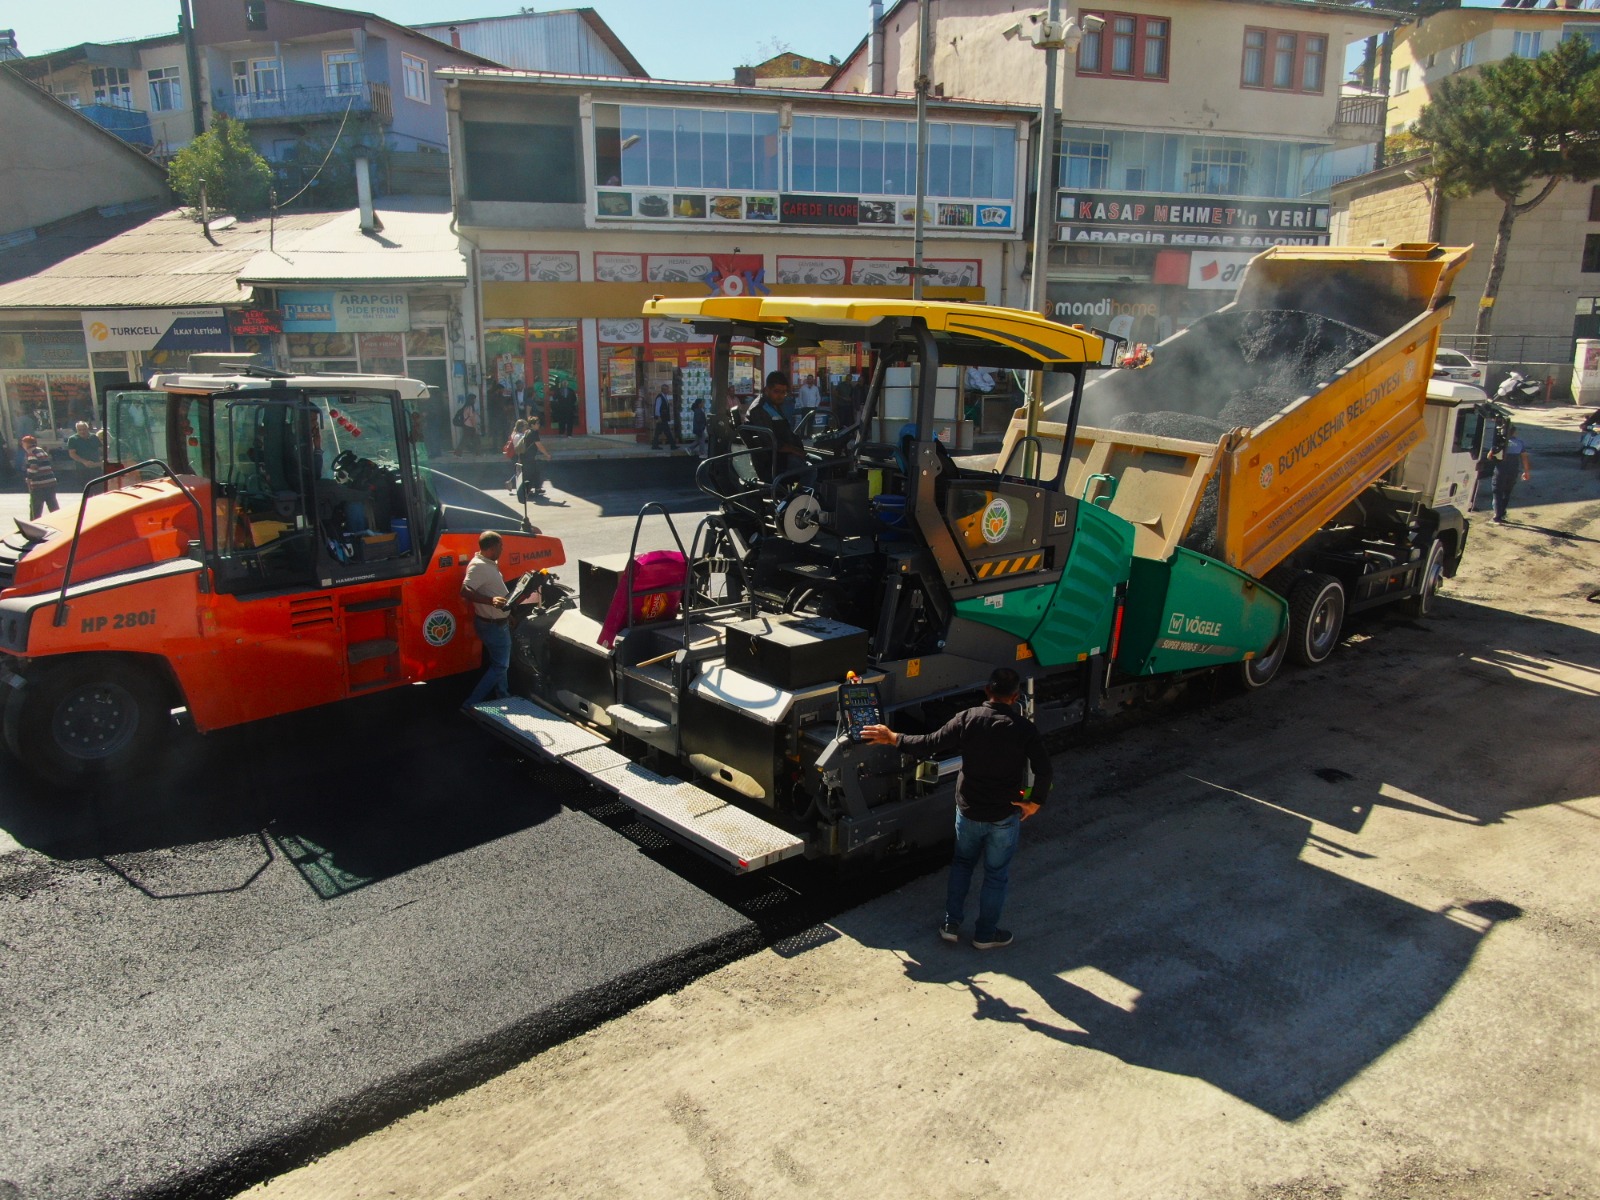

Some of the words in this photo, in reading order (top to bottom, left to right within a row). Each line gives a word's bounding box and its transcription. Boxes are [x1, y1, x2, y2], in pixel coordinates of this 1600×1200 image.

[782, 201, 808, 216] CAFE
[809, 203, 822, 216] DE
[828, 203, 858, 218] FLORE
[1079, 202, 1145, 221] KASAP
[1268, 207, 1311, 228] YERİ
[1075, 228, 1165, 244] ARAPGİR
[1170, 233, 1234, 246] KEBAP
[1240, 236, 1313, 246] SALONU
[340, 293, 404, 305] ARAPGİR
[346, 306, 369, 314] PİDE
[111, 326, 162, 336] TURKCELL
[173, 327, 192, 336] İLKAY
[1278, 411, 1345, 475] BÜYÜKŞEHİR
[1346, 374, 1400, 422] BELEDİYESİ
[523, 549, 552, 560] HAMM
[81, 616, 108, 634] HP
[113, 608, 156, 630] 280i
[1185, 616, 1222, 636] VÖGELE
[1162, 639, 1180, 651] SUPER
